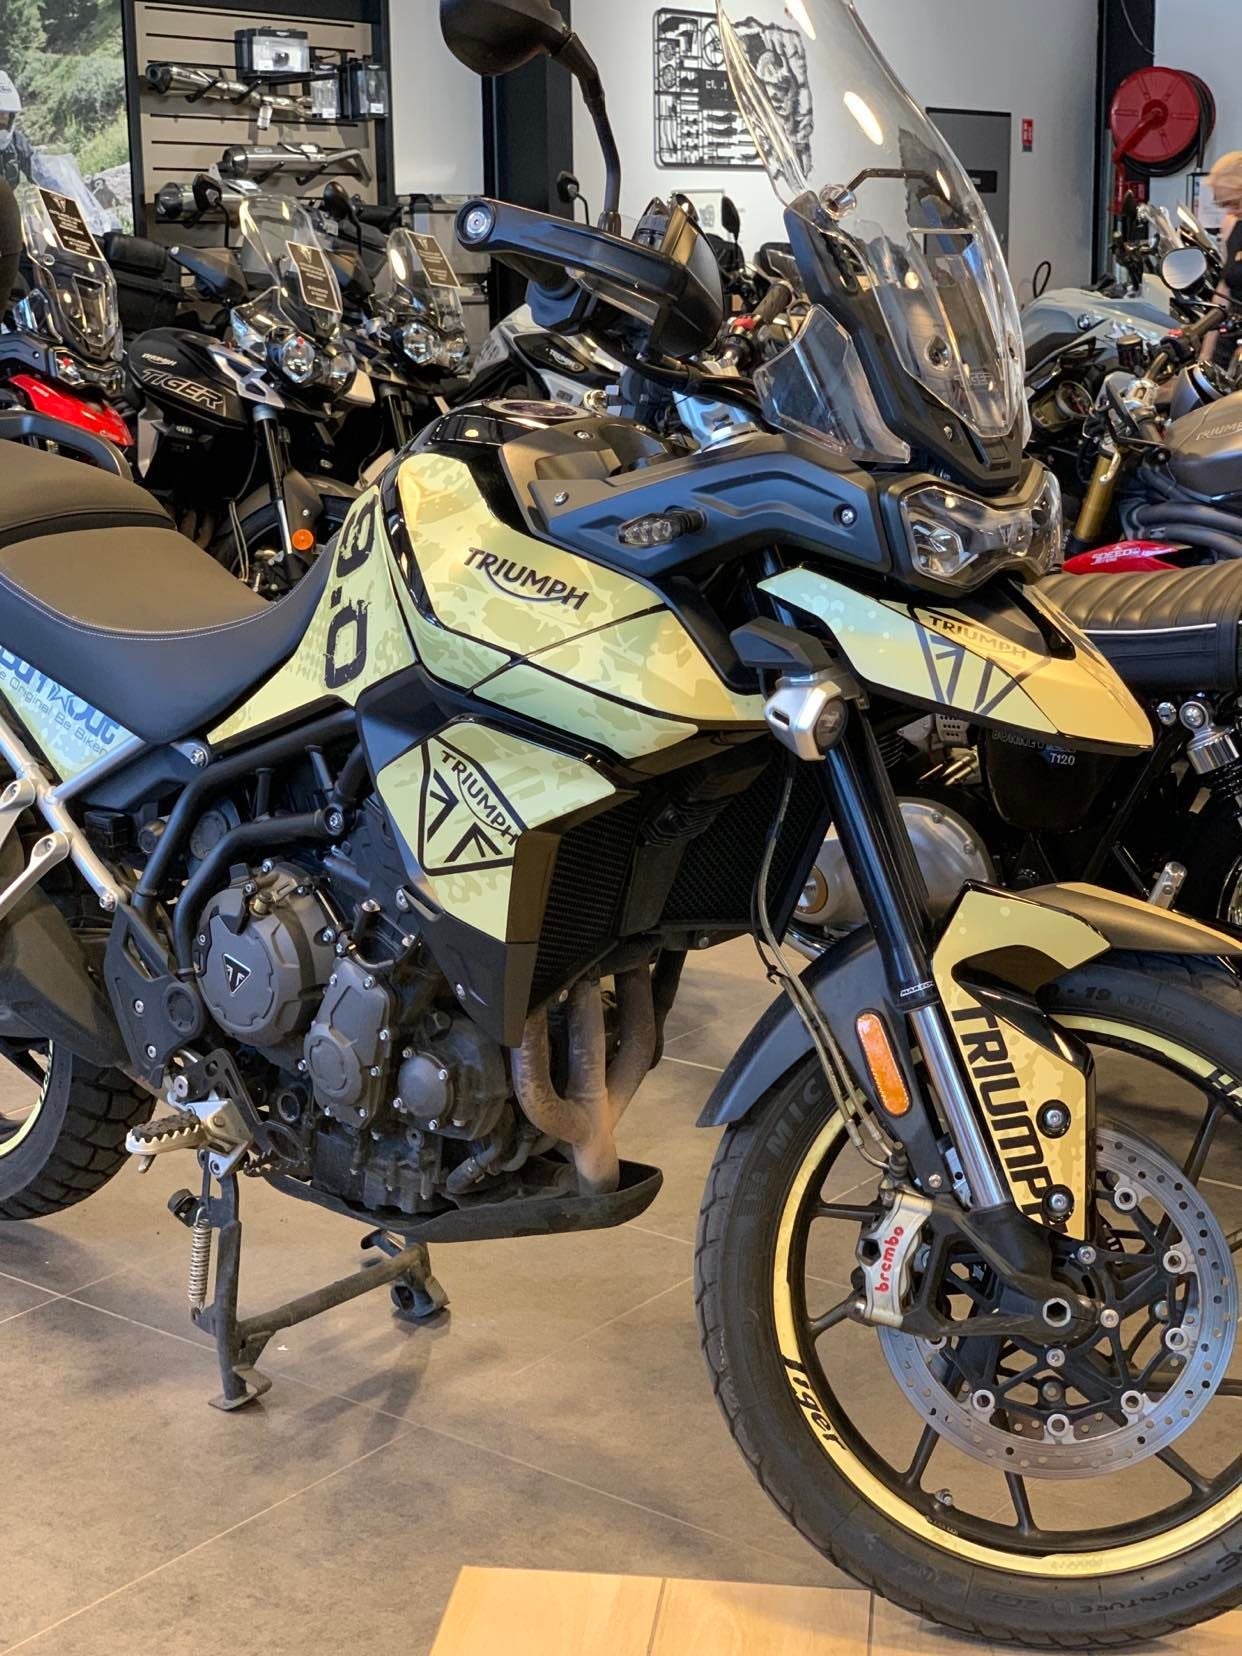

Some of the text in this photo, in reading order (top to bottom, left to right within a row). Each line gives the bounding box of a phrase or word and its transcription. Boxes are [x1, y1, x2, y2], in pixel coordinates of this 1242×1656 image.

[142, 368, 225, 410] TIGER
[464, 546, 590, 611] TRIUMPH
[929, 615, 1027, 659] TRIUMPH
[10, 677, 51, 716] Original
[1050, 753, 1076, 767] T120
[441, 750, 519, 846] TRIUMPH
[874, 1226, 904, 1293] brembo
[1080, 1573, 1212, 1614] ADVENTURE
